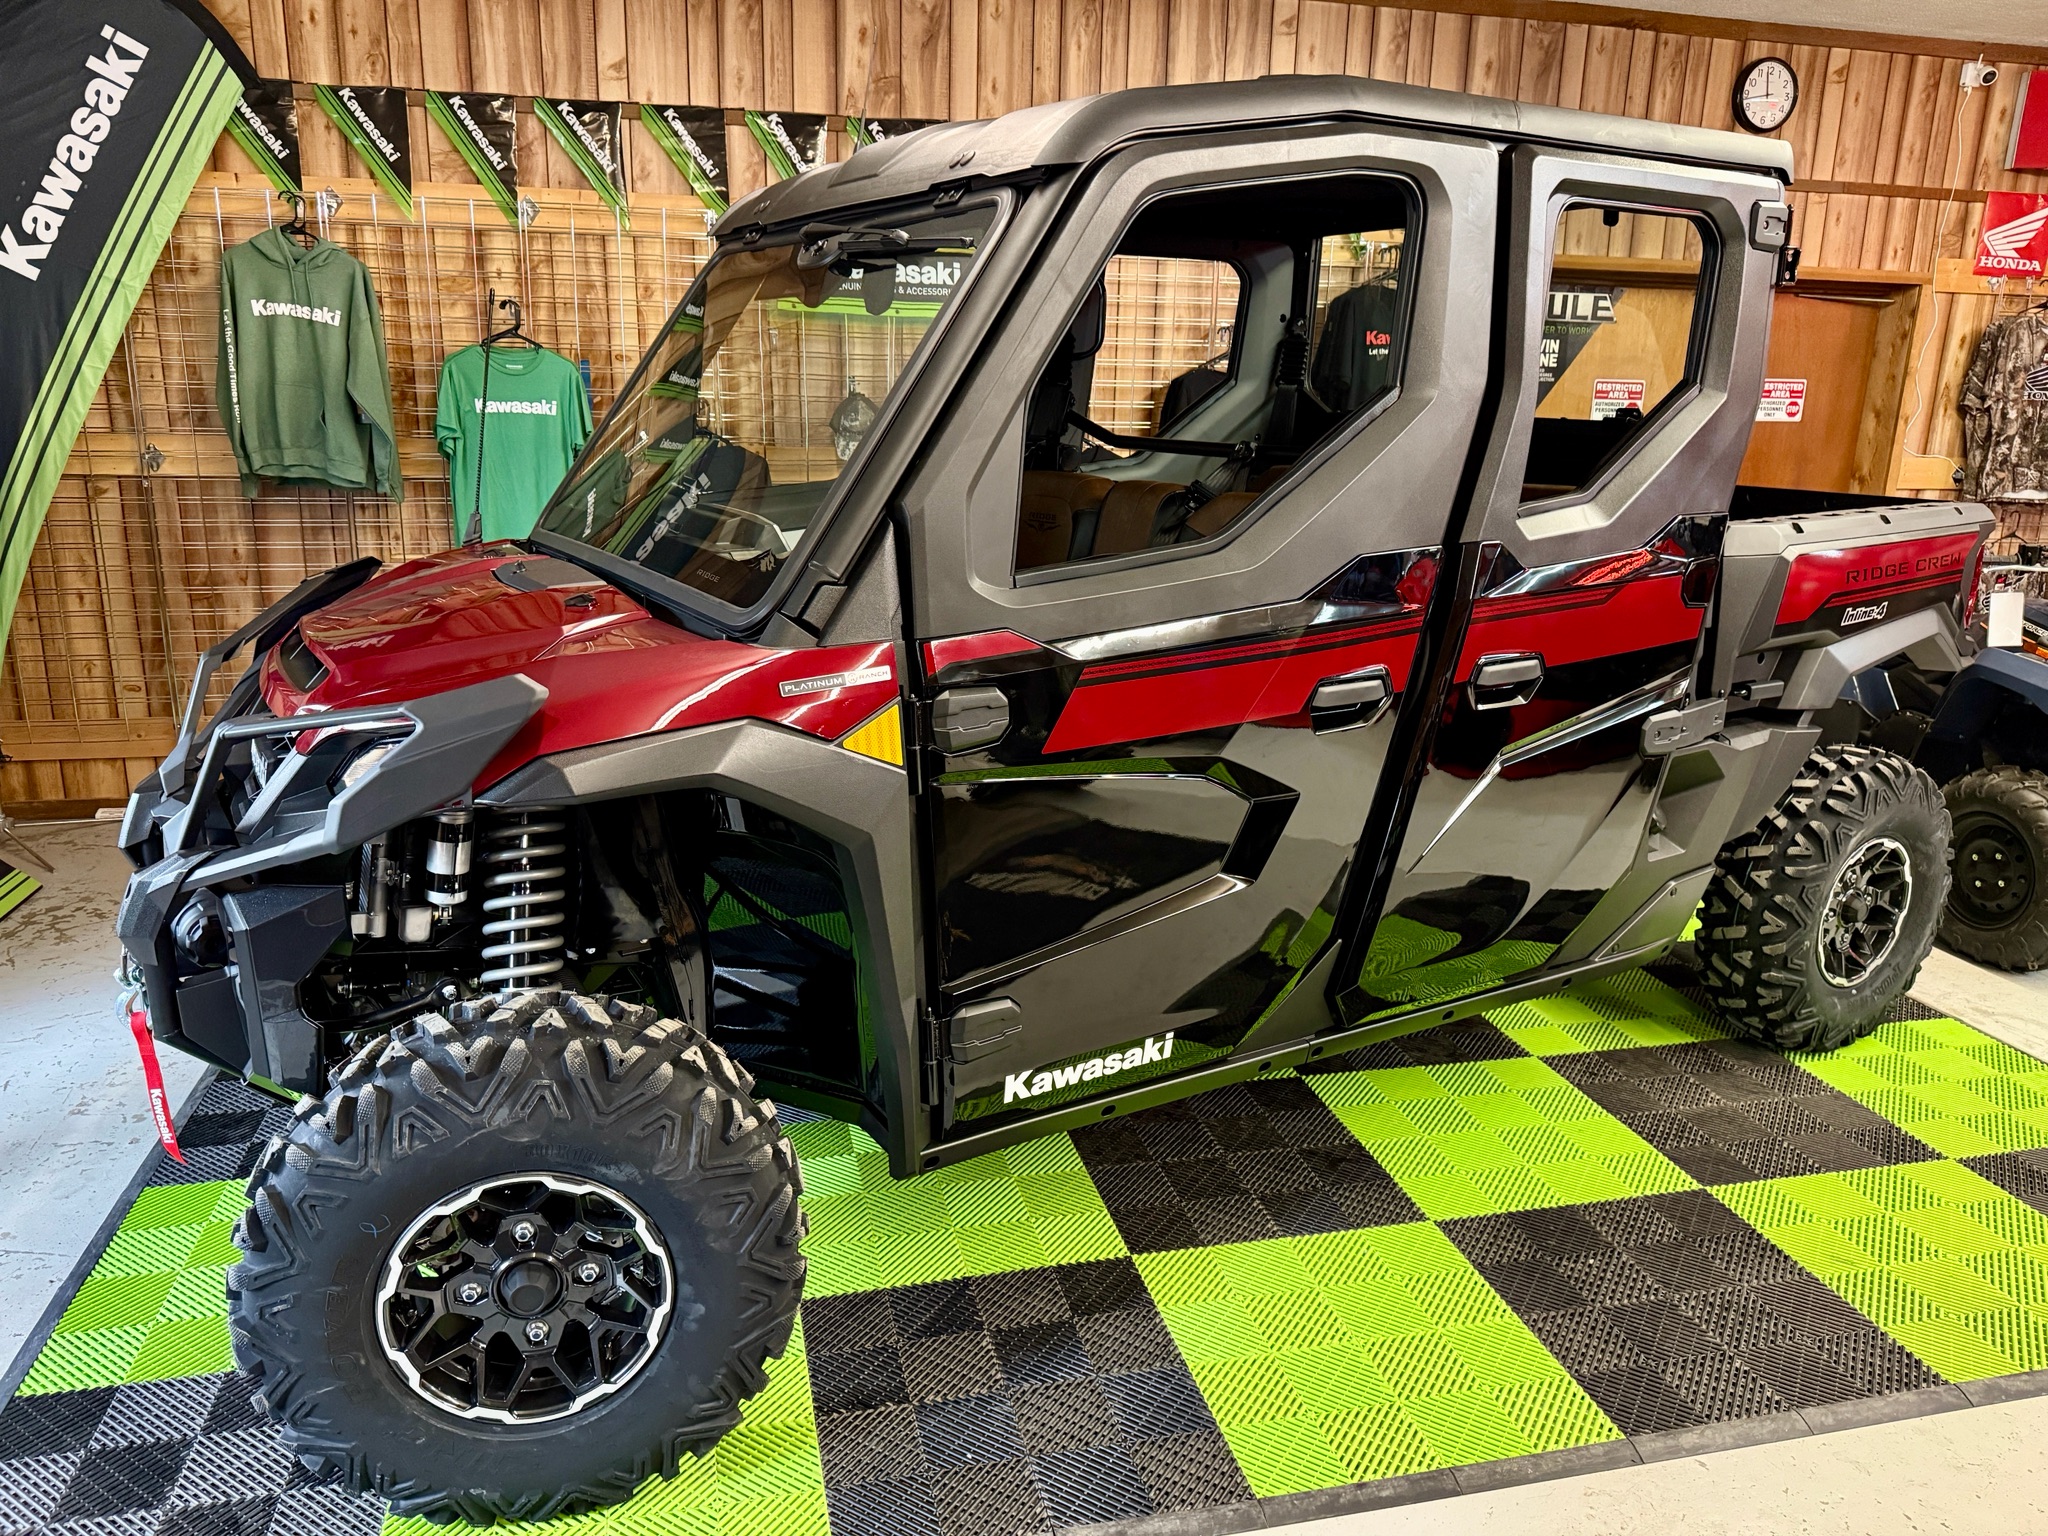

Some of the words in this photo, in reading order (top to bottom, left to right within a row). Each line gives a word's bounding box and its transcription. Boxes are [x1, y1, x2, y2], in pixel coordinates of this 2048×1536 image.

[1758, 69, 1763, 78] 11
[1767, 66, 1775, 76] 12
[1778, 70, 1782, 79] 1
[1749, 78, 1757, 87] 10
[1783, 80, 1789, 89] 2
[1744, 89, 1750, 99] 9
[1784, 92, 1790, 101] 3
[1745, 102, 1751, 111] 8
[1779, 105, 1785, 114] 4
[1751, 112, 1757, 120] 7
[1760, 116, 1766, 125] 6
[1770, 114, 1776, 122] 5
[237, 97, 290, 160] wasaki
[338, 87, 401, 162] Kawasaki
[449, 95, 508, 171] Kawasaki
[557, 101, 617, 172] Kawasaki
[663, 107, 720, 179] Kawasaki
[767, 113, 807, 173] Kawasa
[0, 24, 150, 281] Kawasaki
[1979, 255, 2042, 272] HONDA
[839, 281, 862, 291] NUIN
[906, 287, 952, 297] ACCESSOR
[250, 299, 341, 327] Kawasaki
[1547, 293, 1615, 321] ULE
[1544, 326, 1556, 334] ER
[1557, 326, 1567, 334] TO
[1539, 353, 1559, 367] NE
[1597, 382, 1643, 392] RESTRICTED
[1764, 382, 1804, 391] ESTRICTED
[1608, 390, 1629, 399] AREA
[1770, 390, 1791, 398] AREA
[474, 398, 557, 416] Kawasaki
[1786, 405, 1800, 413] STOP
[696, 568, 721, 583] RIDGE
[1846, 561, 1909, 585] RIDGE
[1915, 552, 1962, 572] CREW
[1841, 601, 1889, 626] Inline-4
[784, 677, 843, 693] PLATINUM
[1003, 1032, 1174, 1104] Kawasaki
[150, 1088, 174, 1144] Kawasaki
